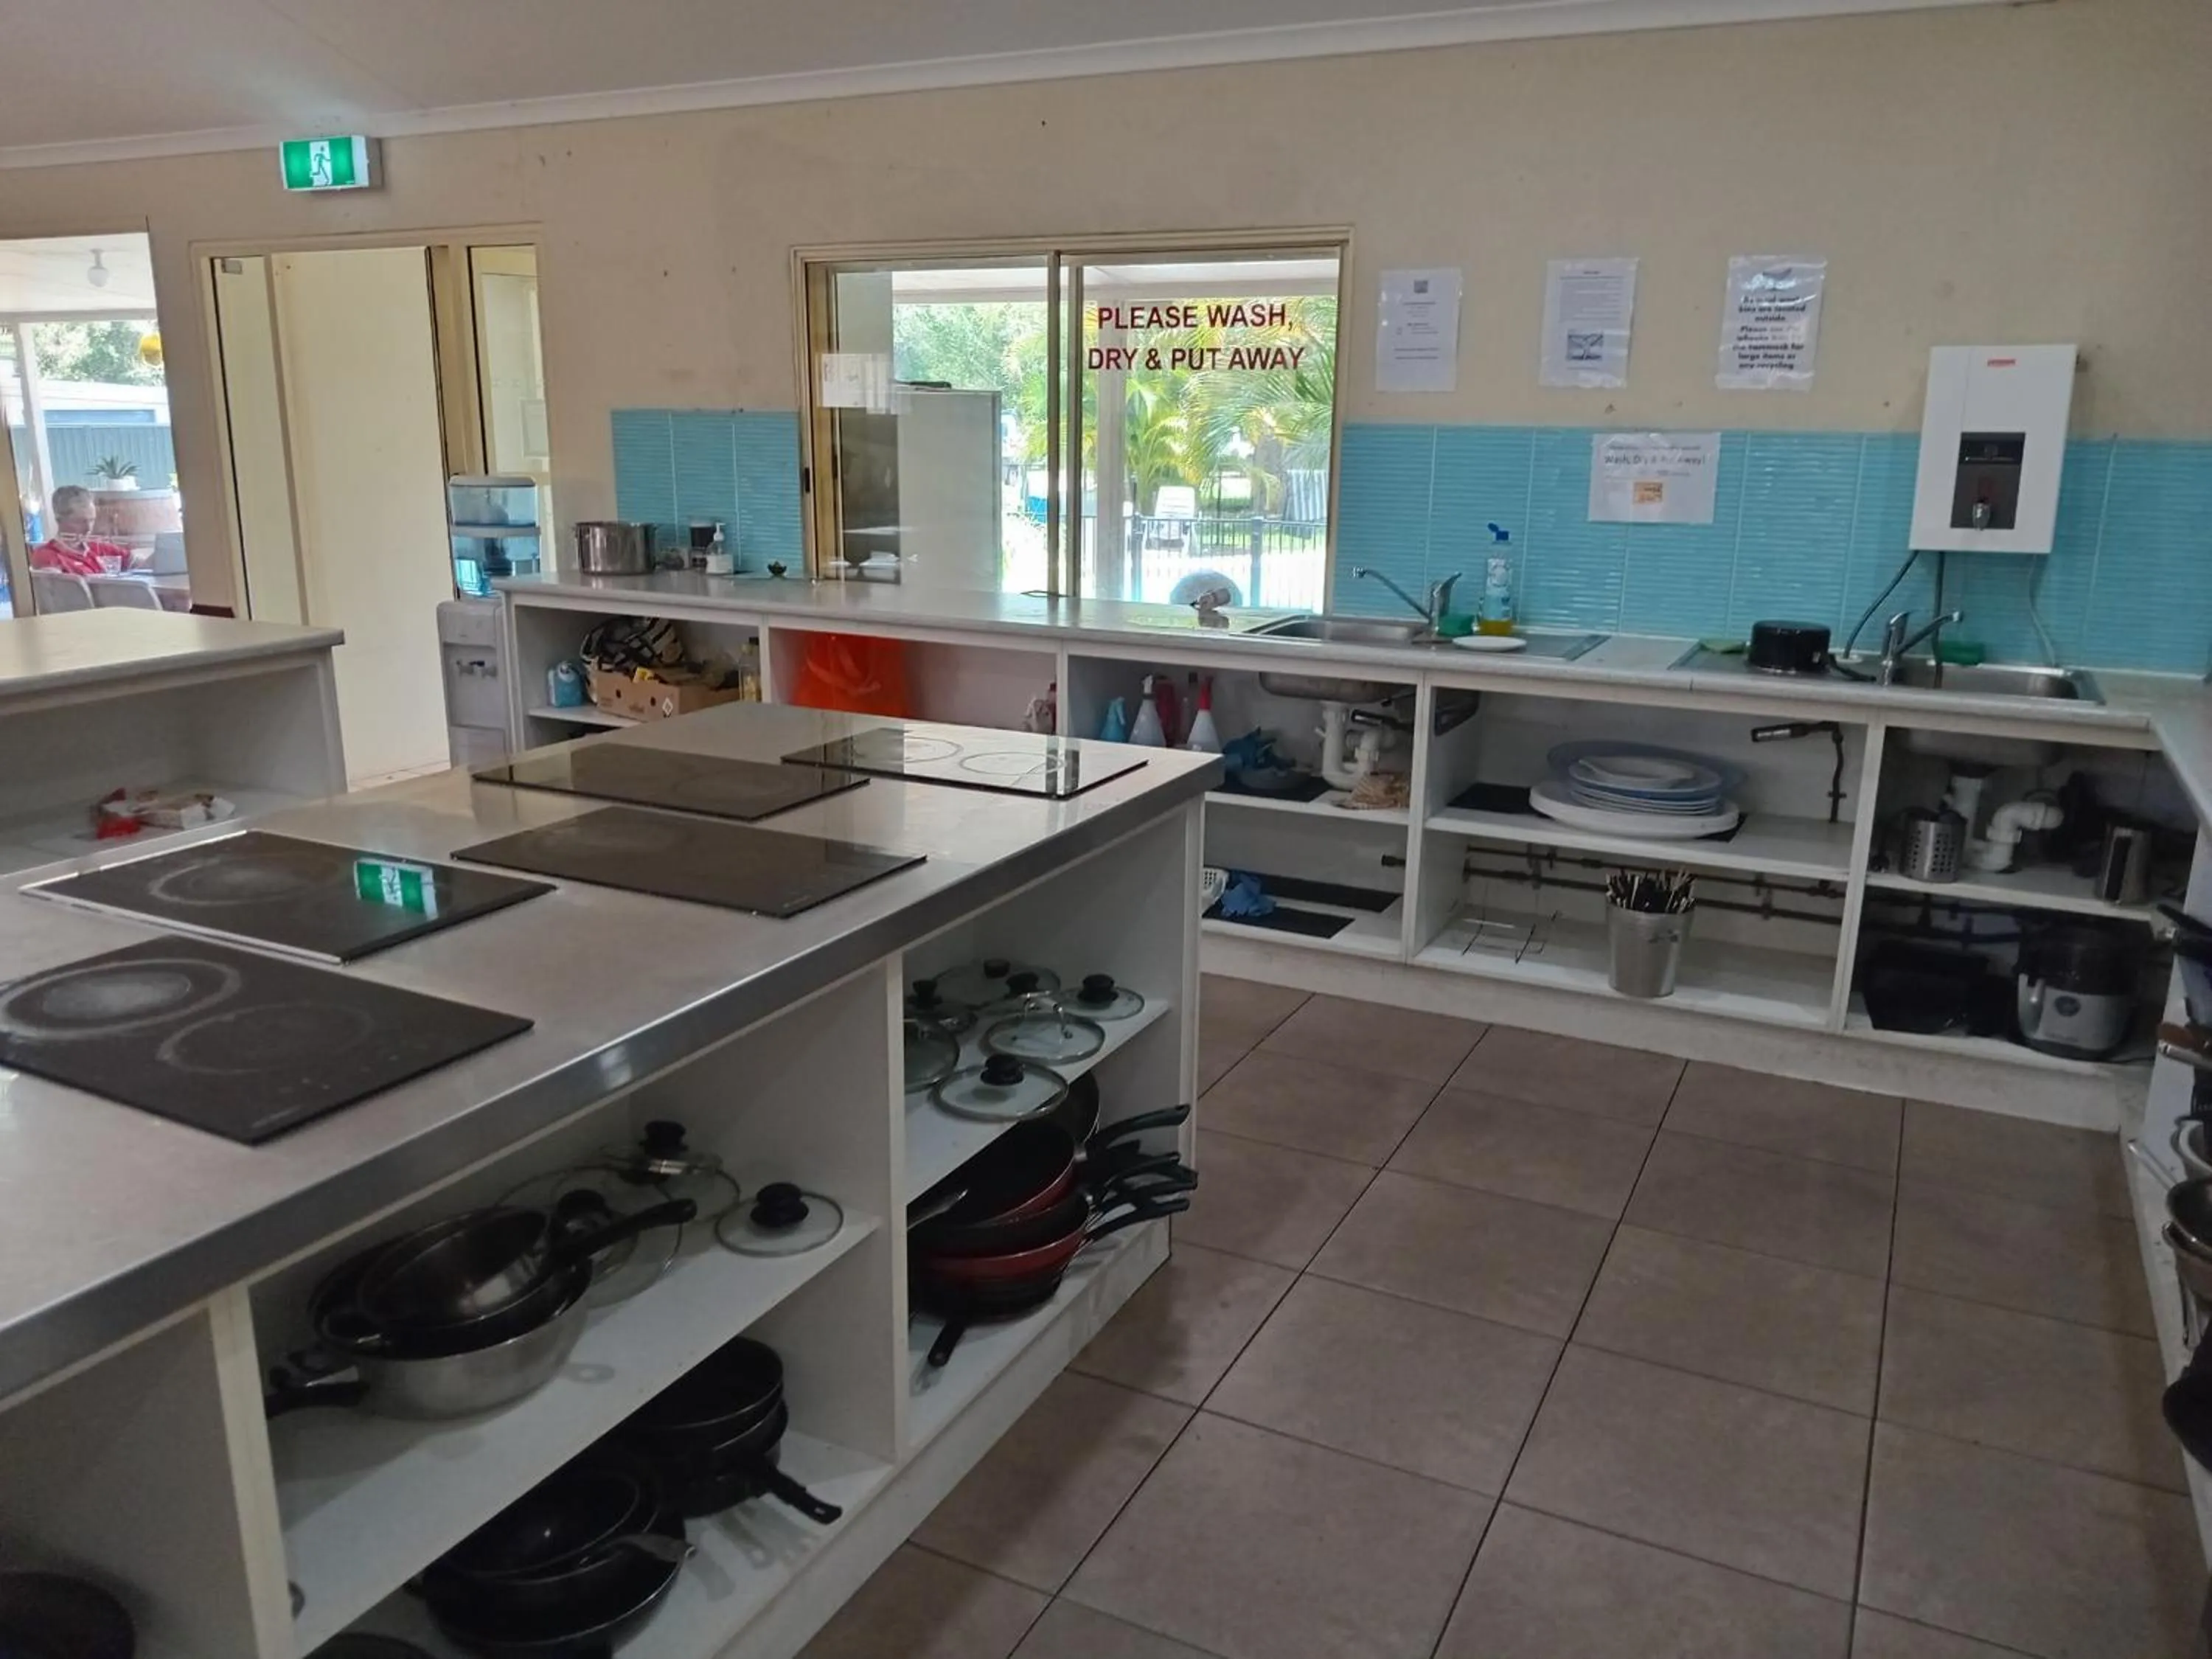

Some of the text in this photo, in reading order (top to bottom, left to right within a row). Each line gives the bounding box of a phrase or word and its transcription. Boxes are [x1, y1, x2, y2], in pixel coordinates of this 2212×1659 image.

[1098, 303, 1293, 331] PLEASE WASH,
[1088, 347, 1305, 370] DRY & PUT AWAY
